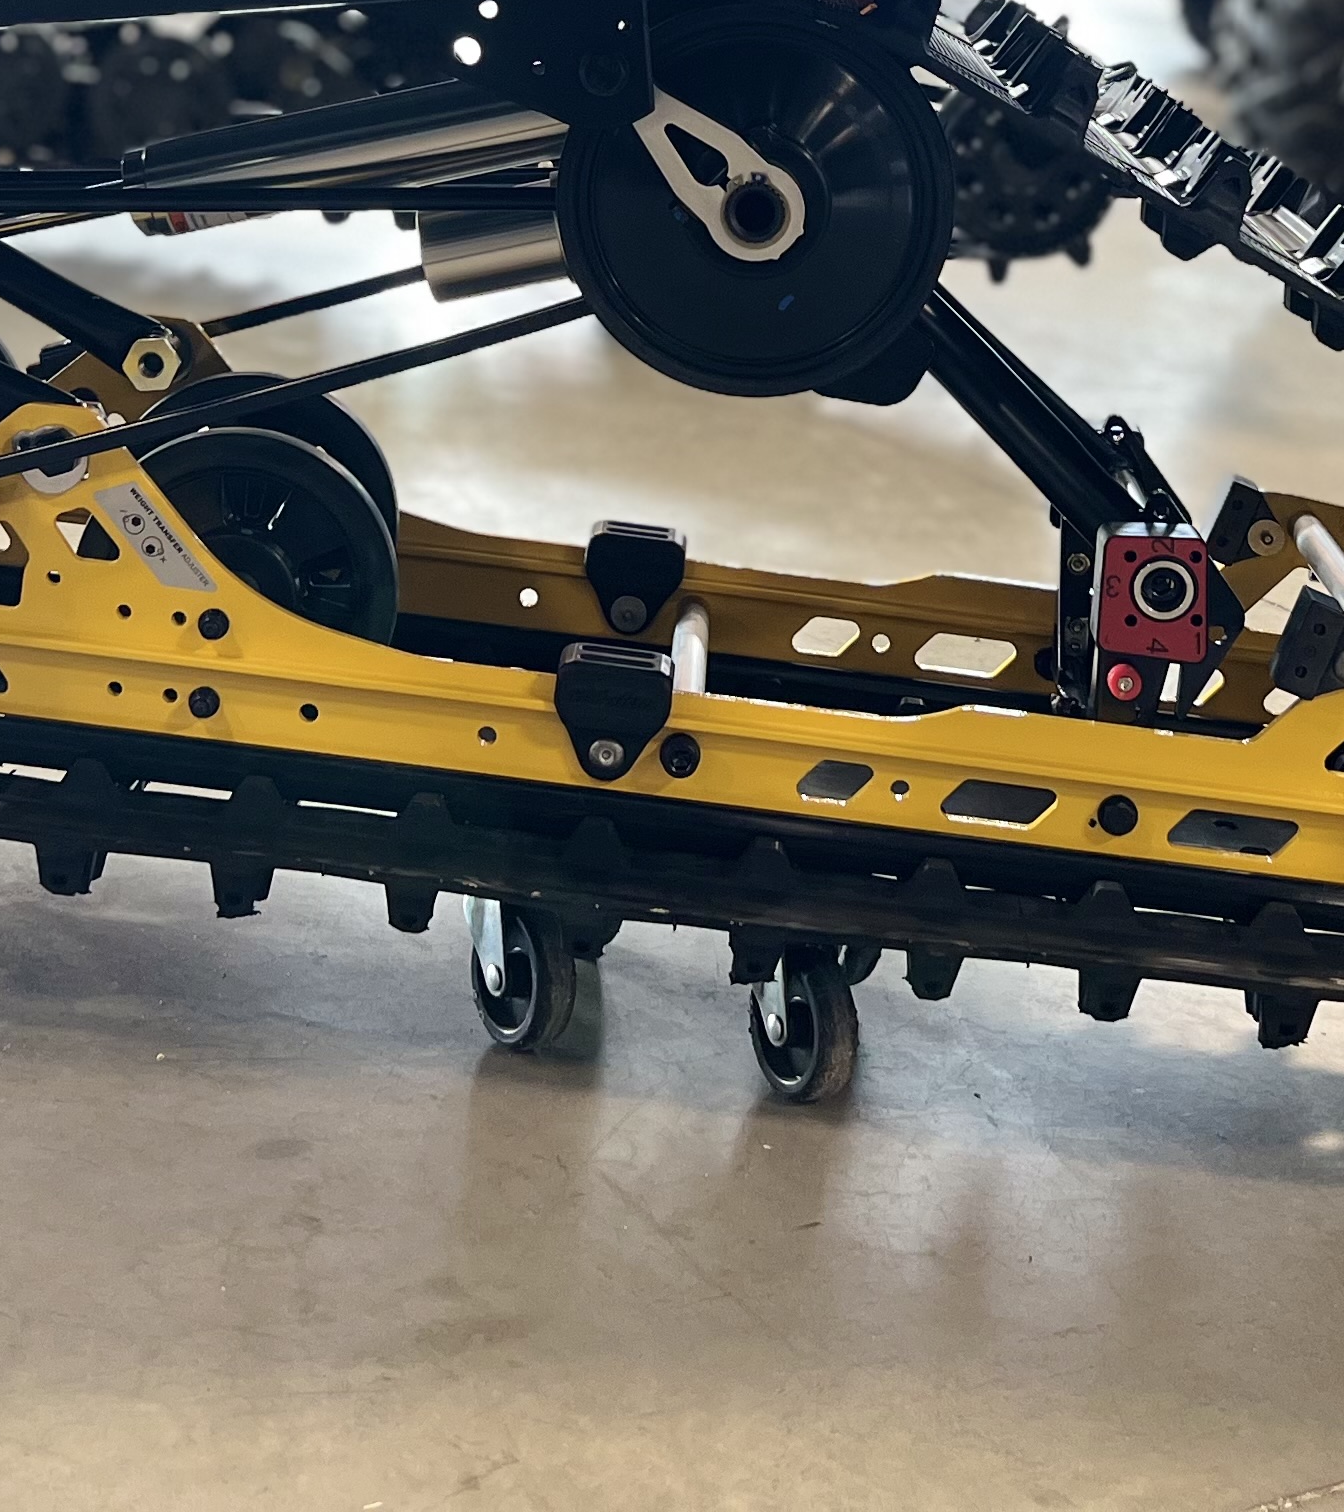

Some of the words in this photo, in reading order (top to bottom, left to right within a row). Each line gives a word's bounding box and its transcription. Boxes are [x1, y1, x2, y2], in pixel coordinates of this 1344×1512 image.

[130, 488, 155, 516] WEIGHT
[153, 515, 184, 554] TRANSFER
[181, 553, 209, 587] ADJUSTER
[1151, 538, 1175, 553] 2
[1106, 575, 1121, 598] 3
[1146, 638, 1169, 654] 4
